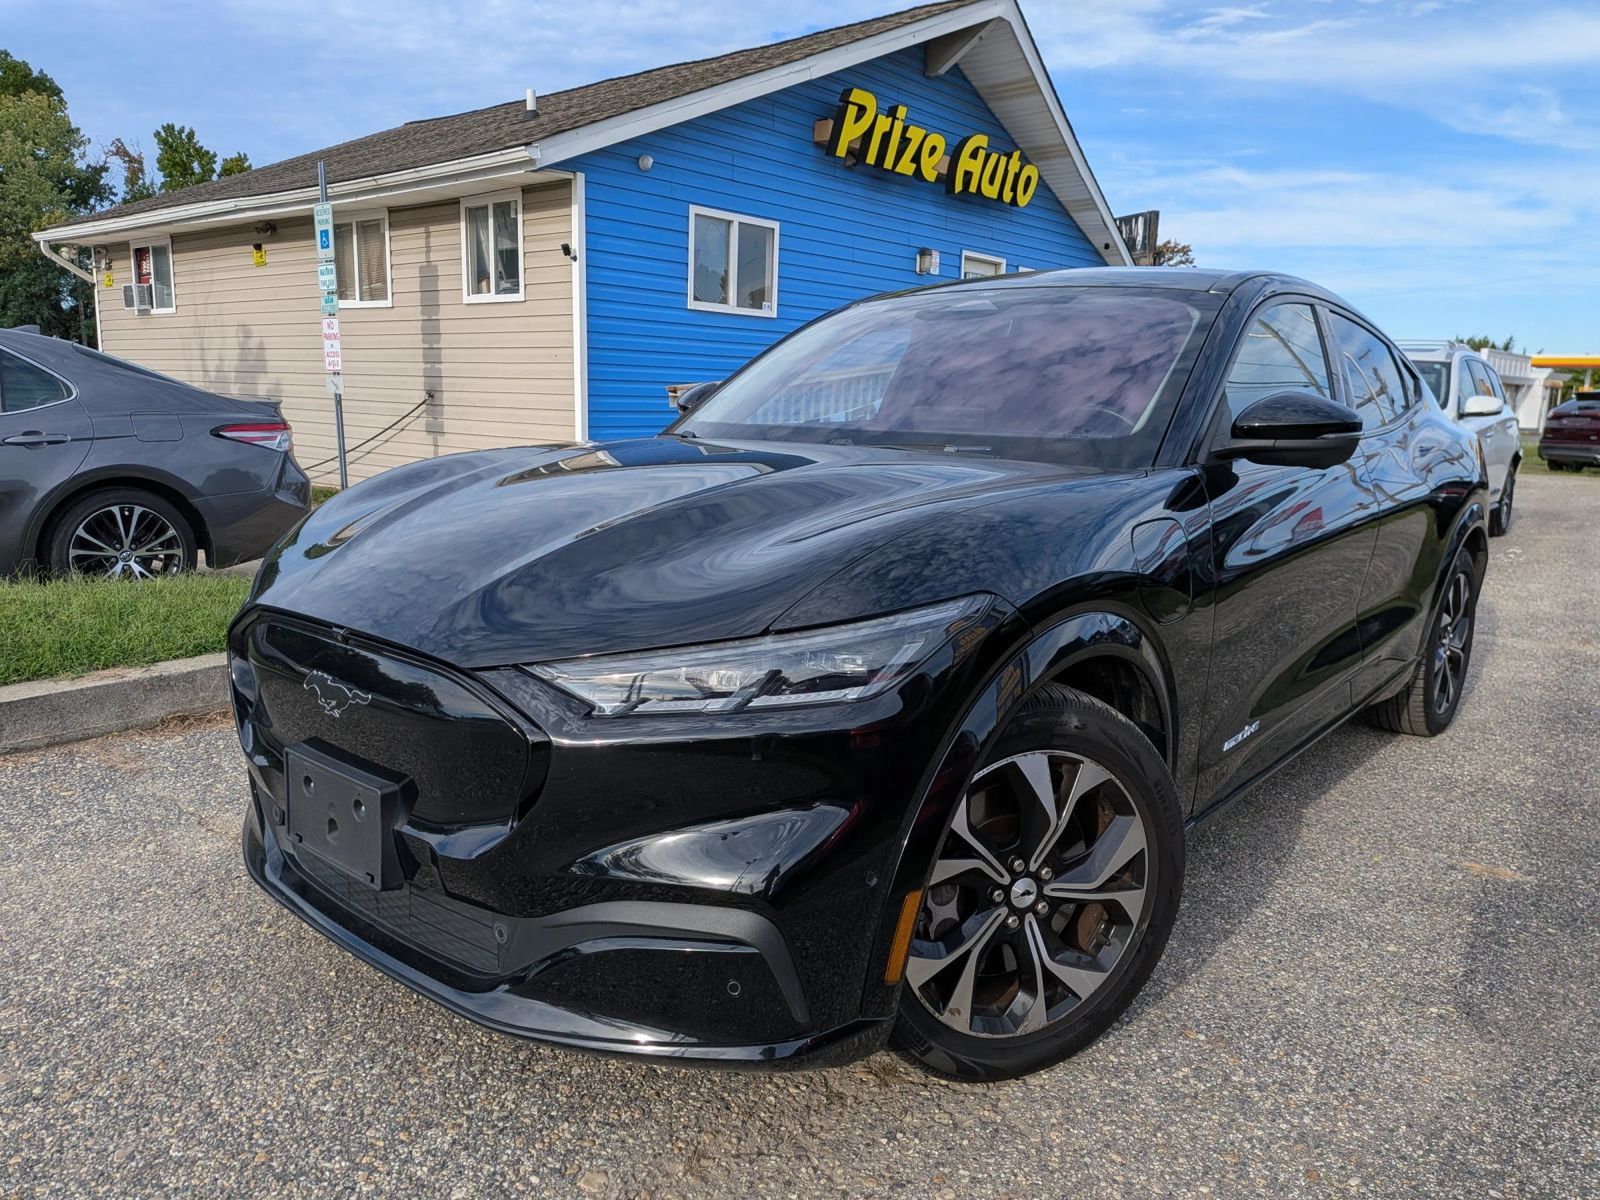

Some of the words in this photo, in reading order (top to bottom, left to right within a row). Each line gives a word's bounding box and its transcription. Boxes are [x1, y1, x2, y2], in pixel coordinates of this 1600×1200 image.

[835, 87, 947, 183] Prize
[955, 133, 1040, 209] Auto
[327, 321, 335, 330] NO
[324, 332, 340, 341] PARKING
